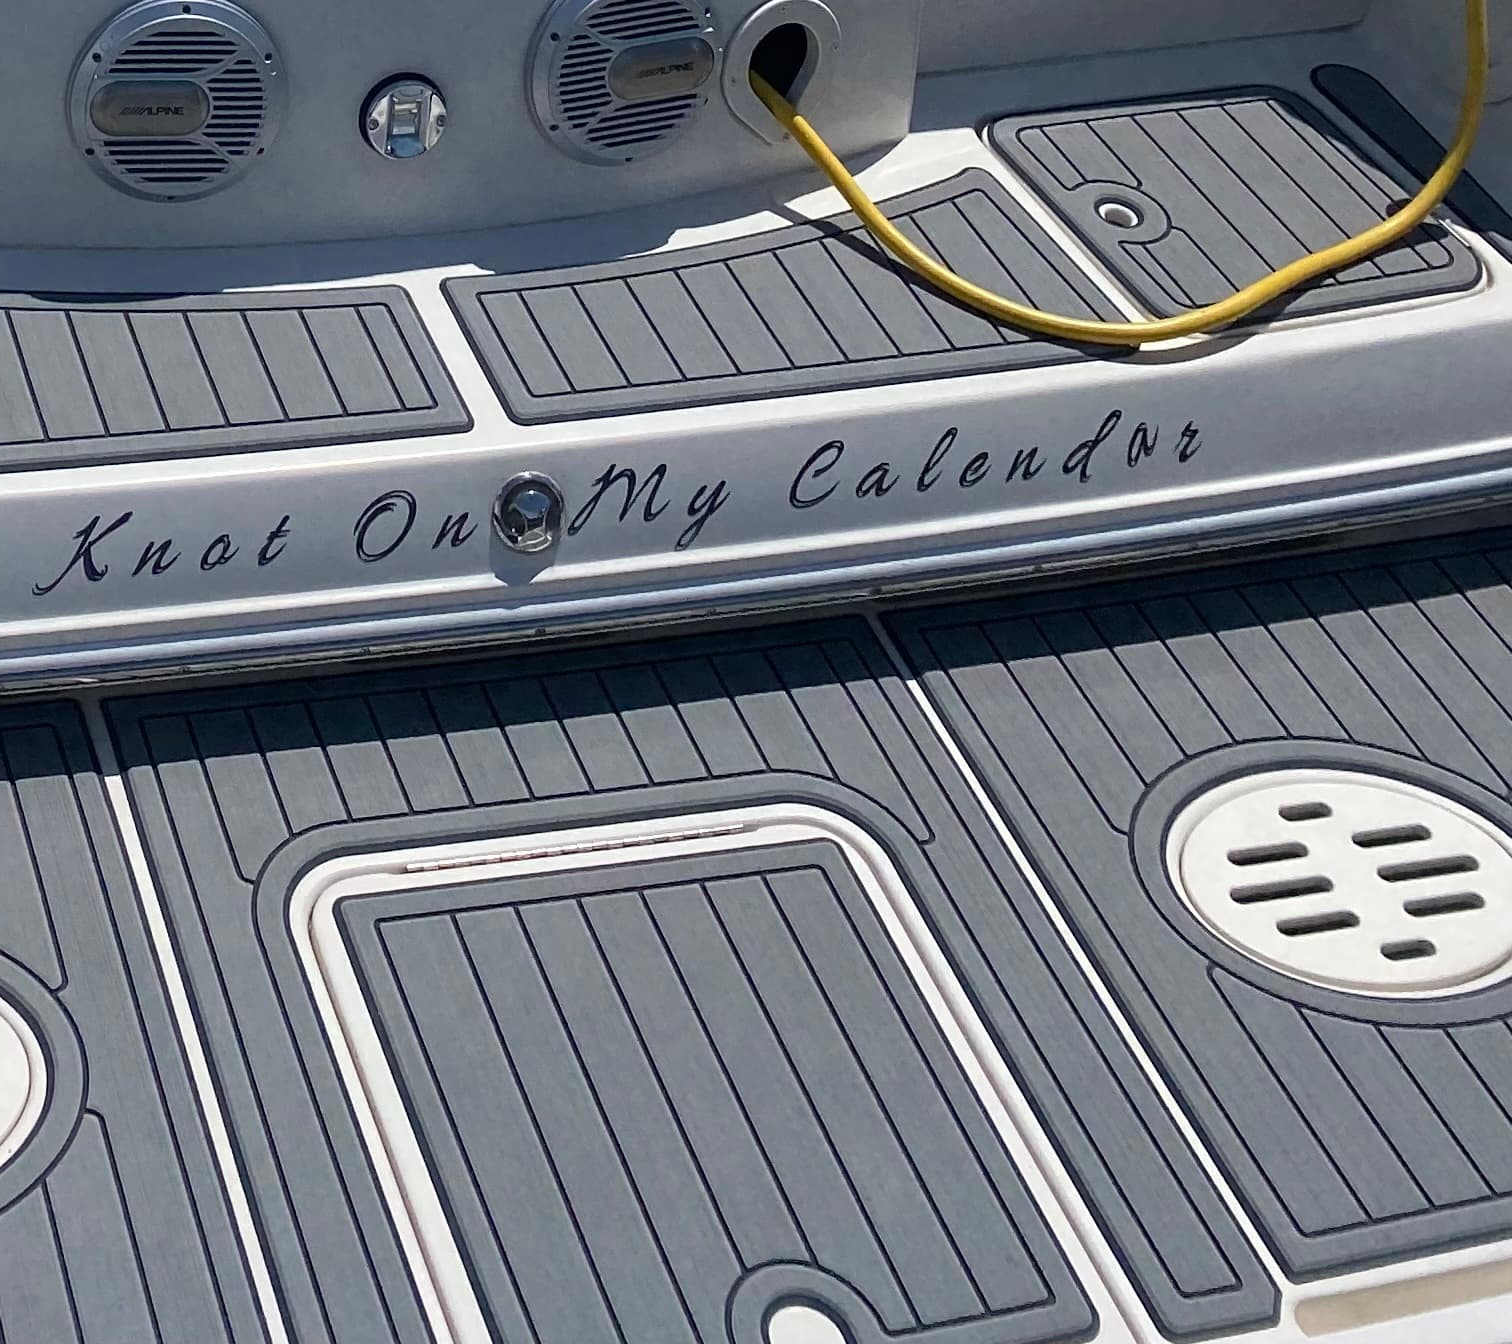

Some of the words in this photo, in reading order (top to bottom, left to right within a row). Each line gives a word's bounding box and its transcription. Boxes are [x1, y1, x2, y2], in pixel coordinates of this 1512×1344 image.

[31, 511, 291, 596] Knot
[353, 489, 478, 563] On
[567, 462, 731, 552] My
[788, 409, 1202, 509] Calendar
